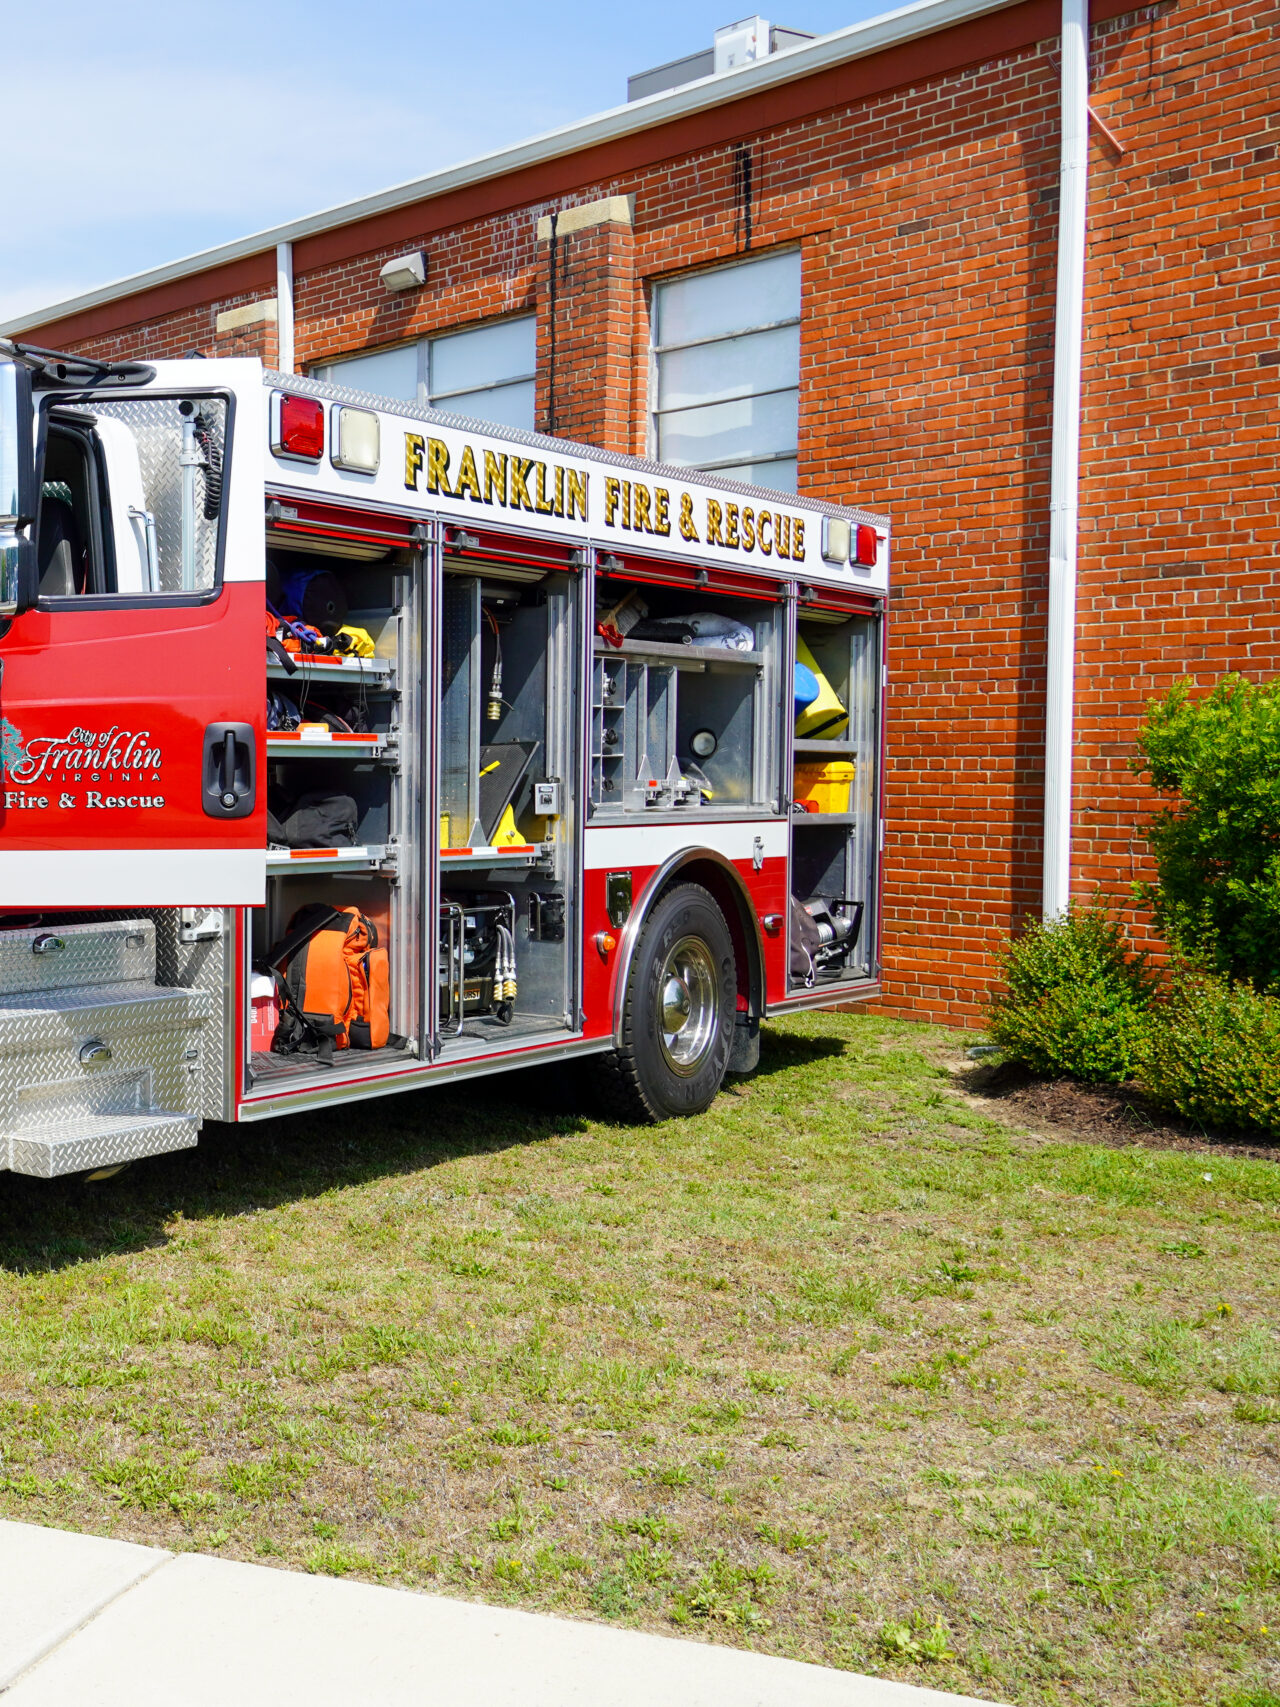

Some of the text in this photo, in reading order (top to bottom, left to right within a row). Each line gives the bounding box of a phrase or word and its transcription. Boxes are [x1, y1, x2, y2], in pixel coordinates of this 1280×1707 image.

[404, 432, 806, 562] FRANKLIN FIRE & RESCUE
[68, 726, 119, 748] City of
[10, 731, 163, 785] Franklin
[45, 773, 161, 782] VIRGINIA
[3, 791, 165, 809] Fire & Rescue
